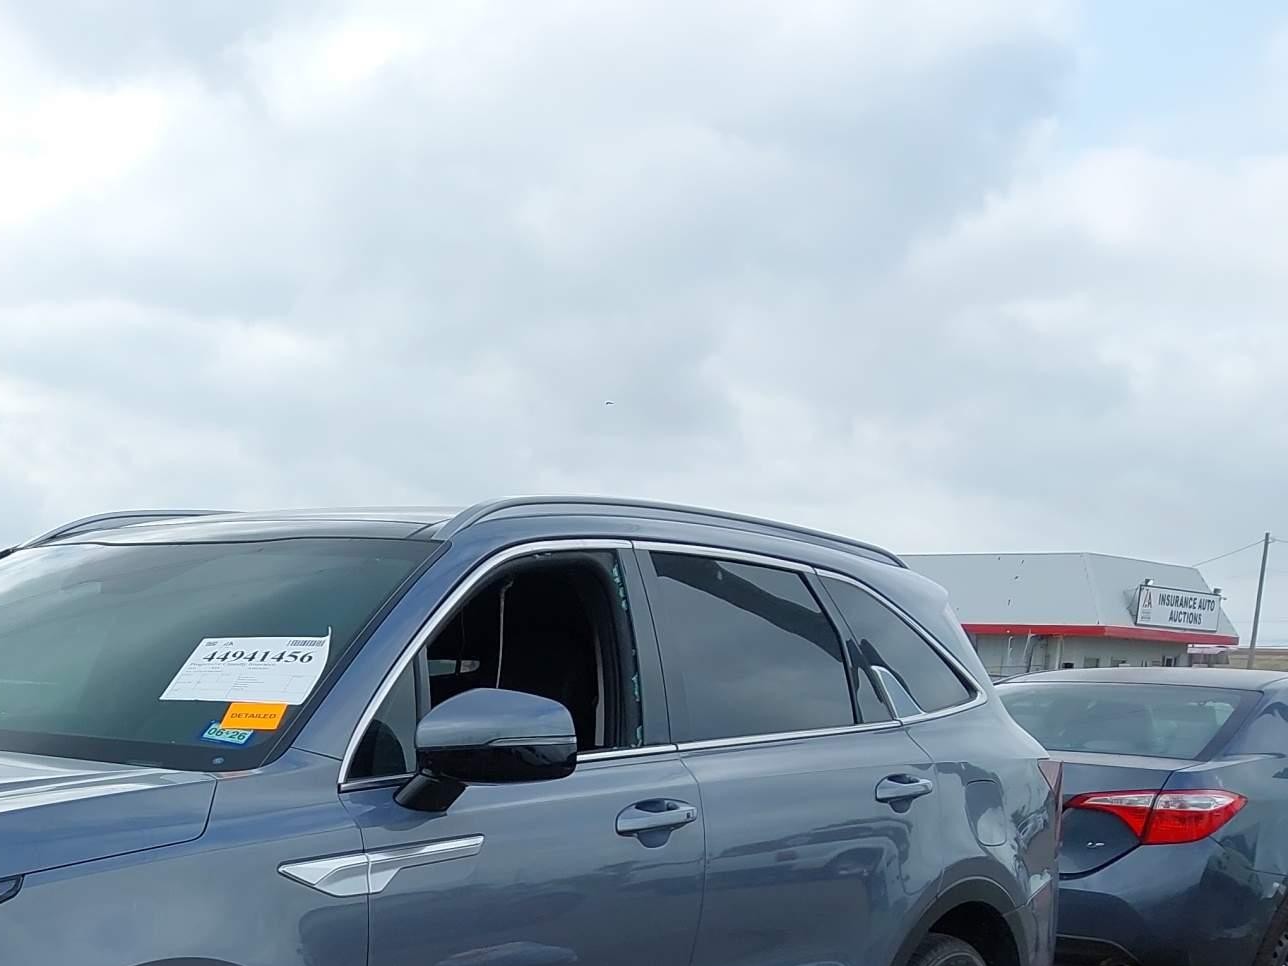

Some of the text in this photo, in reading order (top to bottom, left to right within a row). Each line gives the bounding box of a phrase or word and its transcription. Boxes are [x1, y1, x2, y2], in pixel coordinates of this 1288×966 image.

[1158, 593, 1197, 610] INSURANCE
[1198, 598, 1216, 611] AUTO
[1169, 610, 1202, 625] AUCTIONS
[202, 650, 314, 663] 44941456
